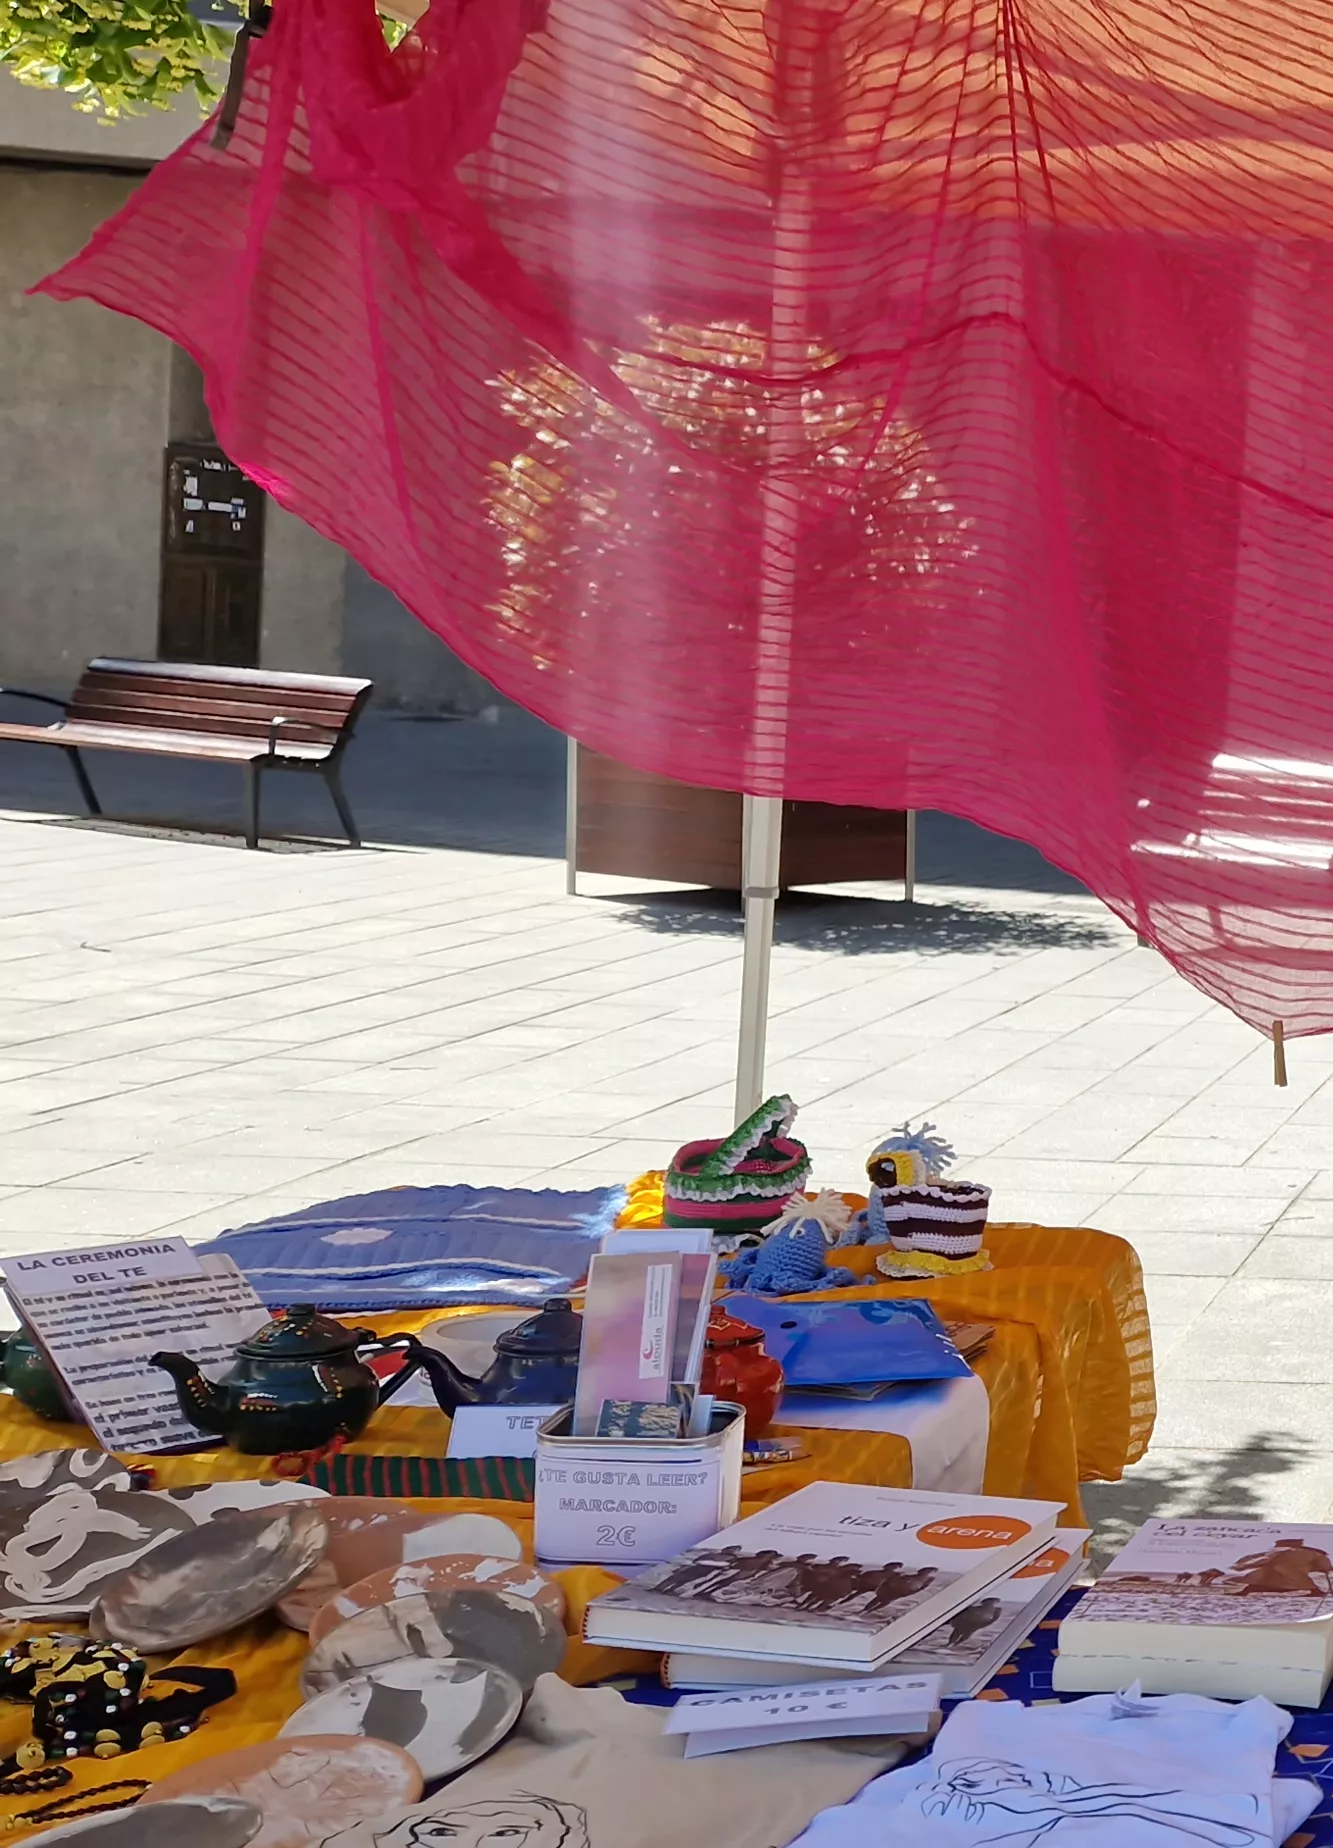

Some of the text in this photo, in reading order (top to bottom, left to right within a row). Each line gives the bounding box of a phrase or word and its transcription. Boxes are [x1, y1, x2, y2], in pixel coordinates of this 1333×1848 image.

[17, 1244, 177, 1271] LA CEREMONIA
[73, 1266, 148, 1285] DEL TE
[573, 1471, 640, 1486] GUSTA
[647, 1472, 708, 1487] LEER?
[559, 1498, 677, 1514] MARCADOR:
[838, 1515, 1013, 1540] tiza y arena
[690, 1681, 928, 1706] CAMISETAS
[763, 1704, 810, 1715] 10
